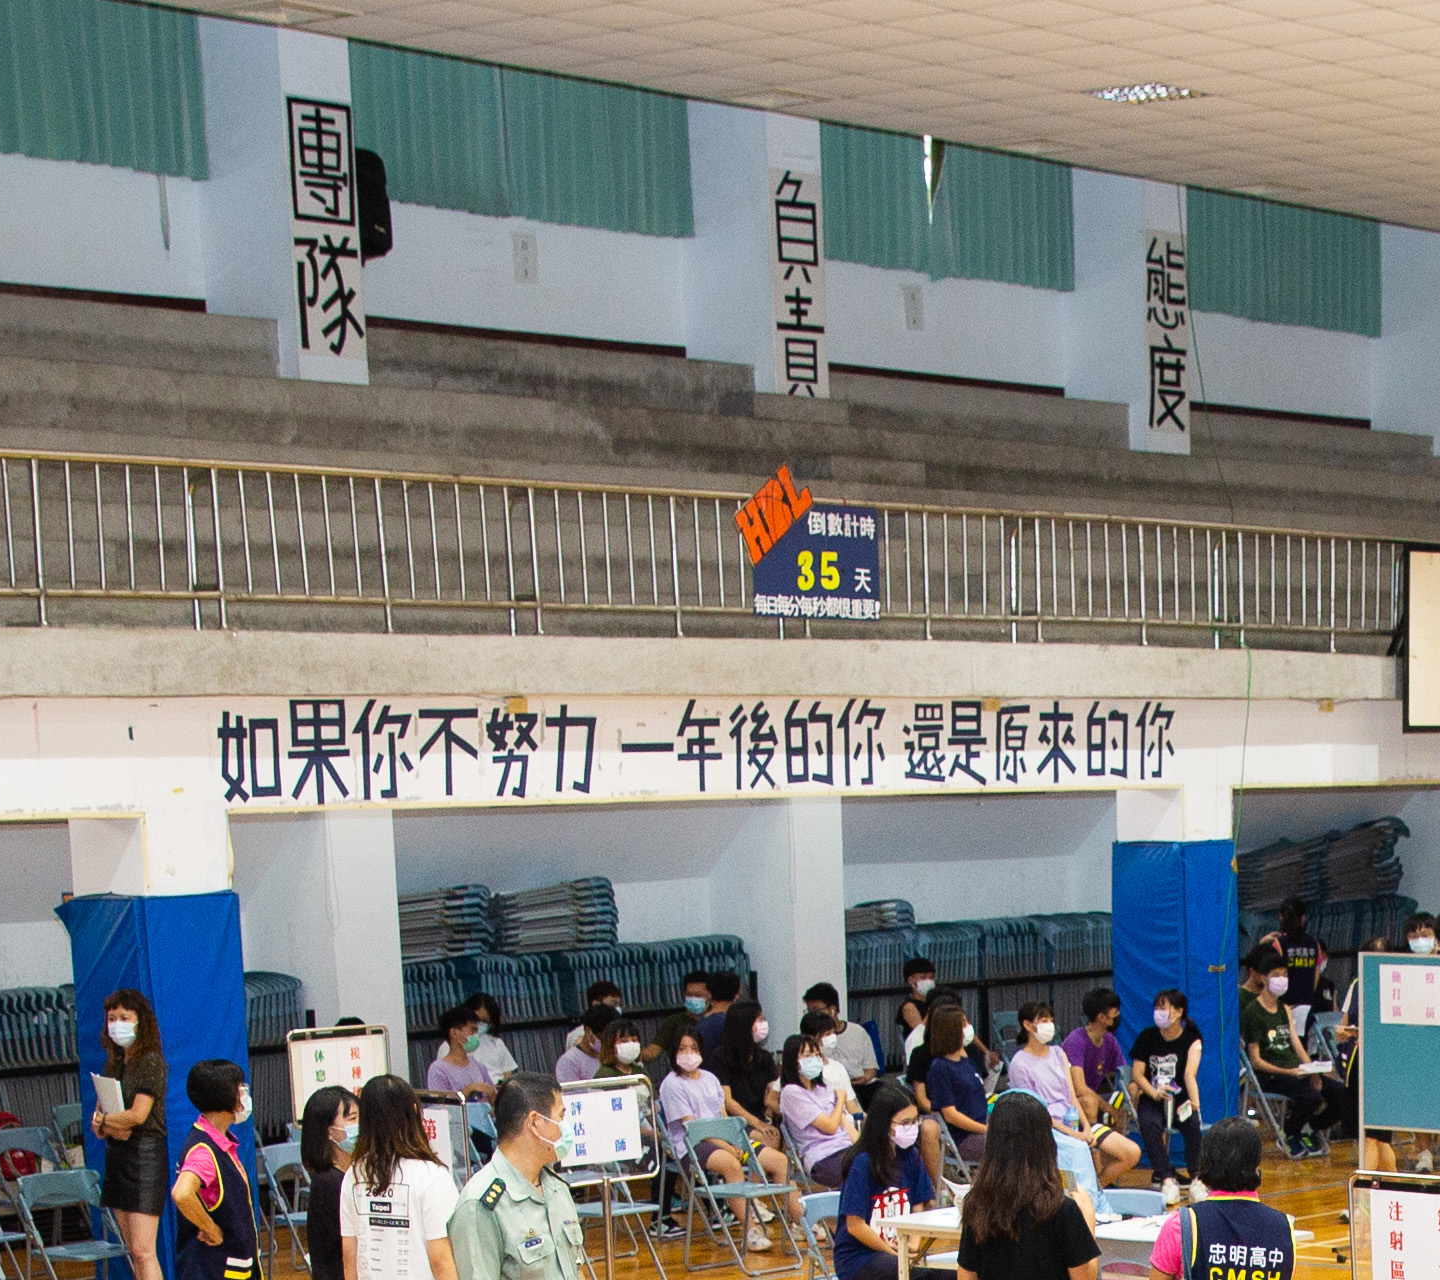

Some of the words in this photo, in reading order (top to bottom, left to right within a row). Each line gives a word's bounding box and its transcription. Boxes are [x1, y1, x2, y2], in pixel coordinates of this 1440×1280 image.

[286, 96, 365, 355] 團隊
[773, 170, 827, 398] 負責
[1145, 238, 1187, 432] 態度
[808, 511, 876, 540] 倒數計時
[797, 550, 840, 591] 35
[854, 568, 871, 593] 天
[218, 699, 597, 804] 如果你不努力
[622, 698, 885, 792] 一年後的你
[903, 700, 1176, 784] 還是原來的你
[571, 1101, 587, 1157] 評估區
[1208, 1242, 1284, 1268] 忠明高中
[1389, 1201, 1405, 1280] 注射區
